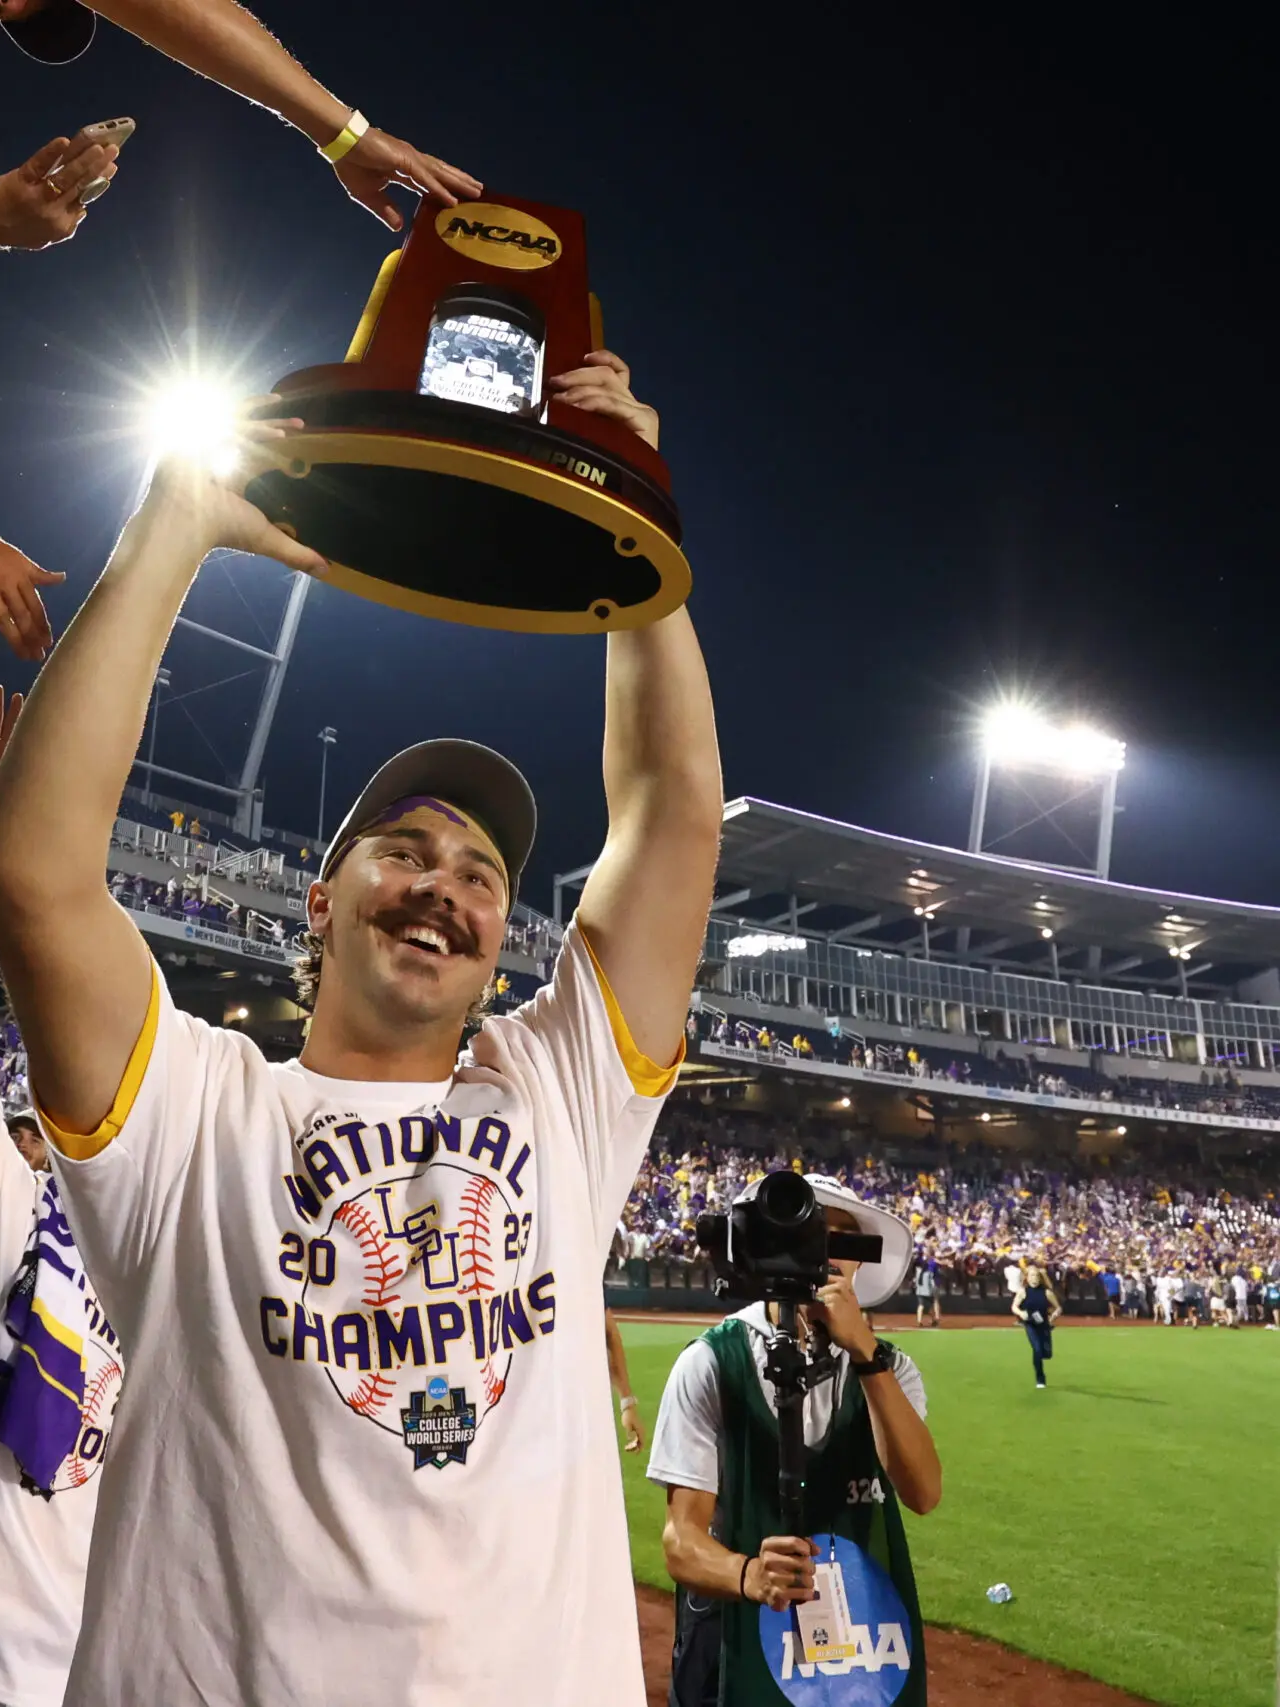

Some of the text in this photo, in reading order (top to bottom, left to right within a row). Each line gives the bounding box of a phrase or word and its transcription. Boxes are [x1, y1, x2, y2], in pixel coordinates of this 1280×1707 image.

[441, 217, 558, 257] NCAA
[442, 319, 521, 346] DIVISION
[284, 1110, 532, 1226] NATIONAL
[278, 1212, 533, 1287] 20 23
[373, 1187, 461, 1291] LSU
[260, 1271, 557, 1371] CHAMPIONS
[406, 1428, 475, 1446] WORLD SERIES
[418, 1417, 462, 1432] COLLEGE
[846, 1478, 886, 1504] 324
